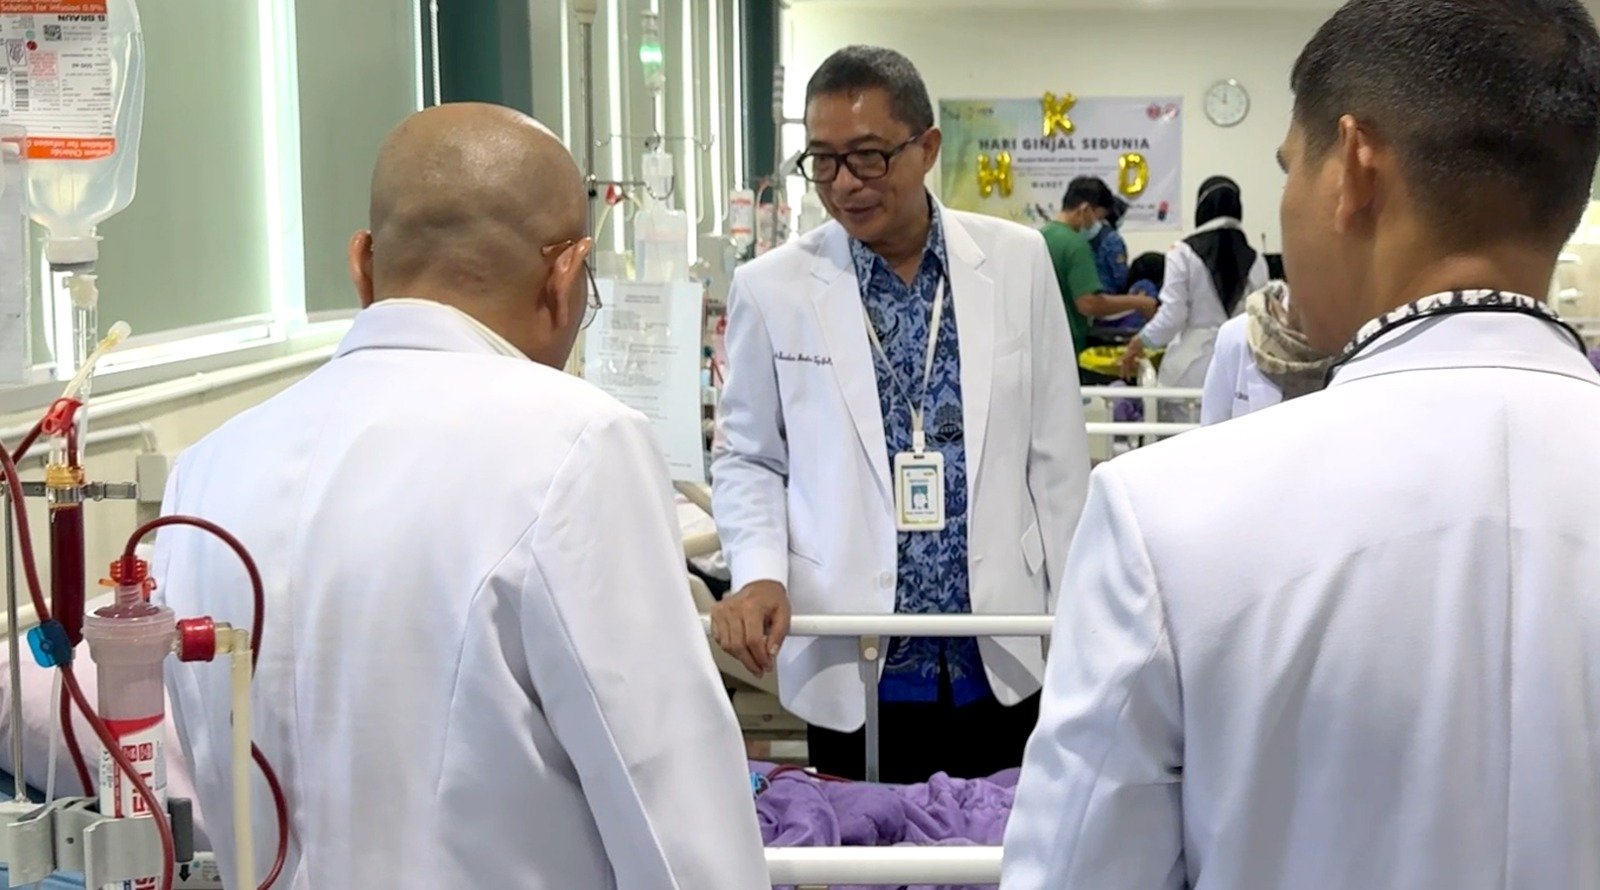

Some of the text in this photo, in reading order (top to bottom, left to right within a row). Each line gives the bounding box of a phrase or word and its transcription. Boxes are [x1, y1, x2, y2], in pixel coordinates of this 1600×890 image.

[36, 4, 47, 12] for
[1041, 92, 1076, 137] K
[979, 137, 1150, 152] HARI GINJAL SEDUNIA
[1118, 153, 1149, 197] D
